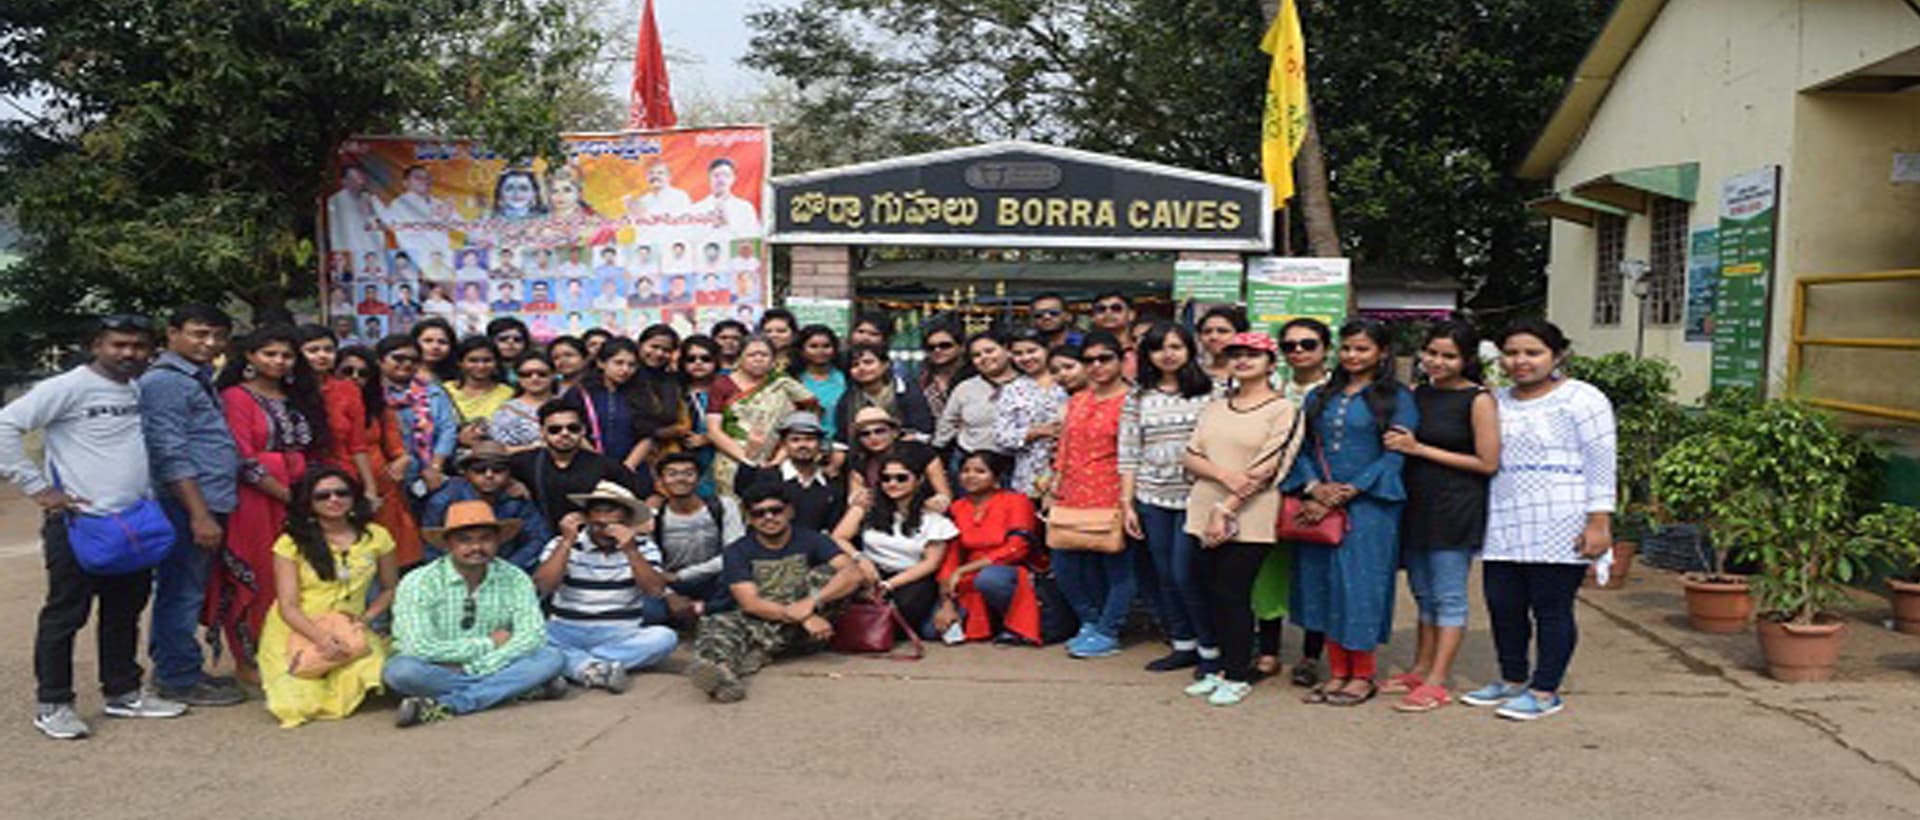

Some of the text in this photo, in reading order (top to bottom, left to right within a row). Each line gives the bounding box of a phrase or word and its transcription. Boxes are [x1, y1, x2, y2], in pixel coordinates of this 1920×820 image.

[871, 189, 979, 226] గుహలు
[997, 197, 1242, 230] BORRA CAVES
